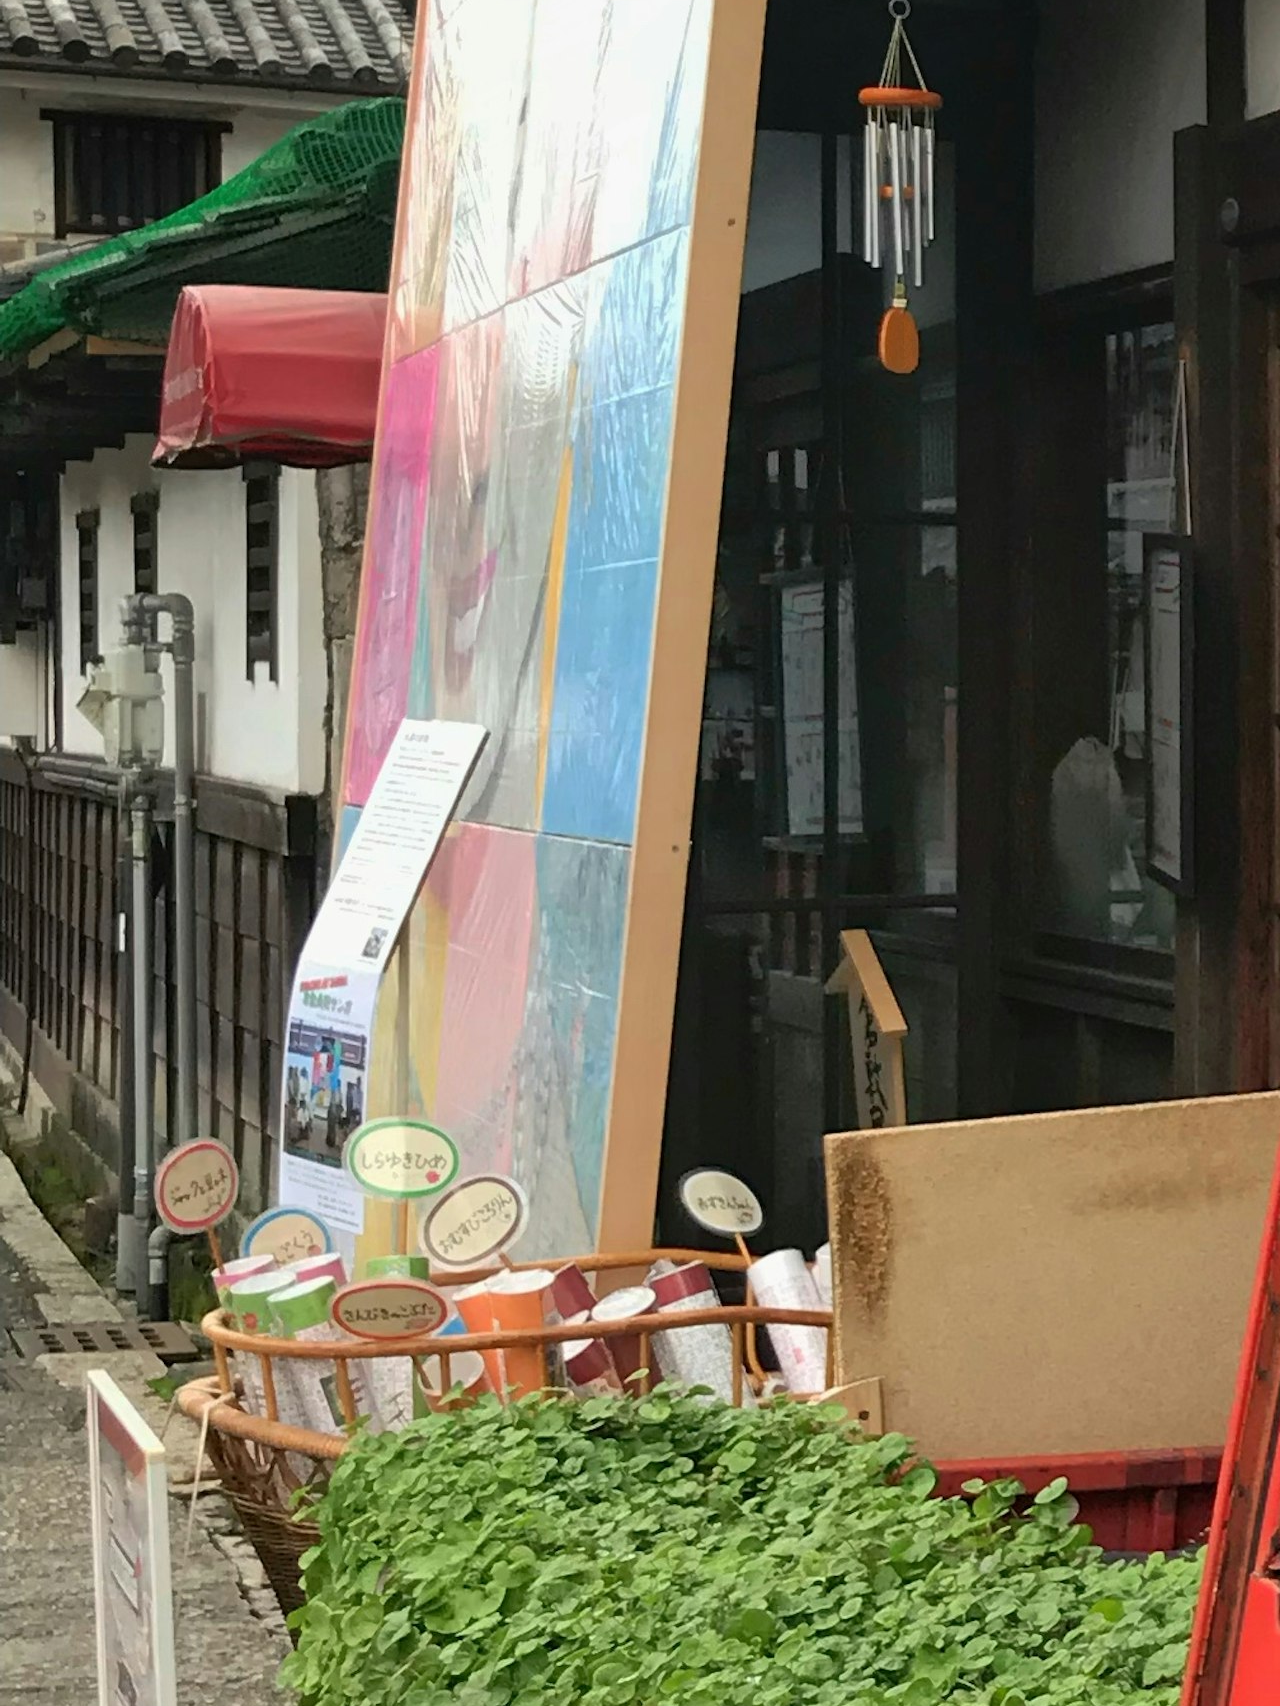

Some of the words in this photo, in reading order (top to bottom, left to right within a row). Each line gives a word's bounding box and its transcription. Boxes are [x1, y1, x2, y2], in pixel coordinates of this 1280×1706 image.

[361, 1151, 448, 1173] しらゆきひめ
[438, 1194, 514, 1255] おむすびころりん
